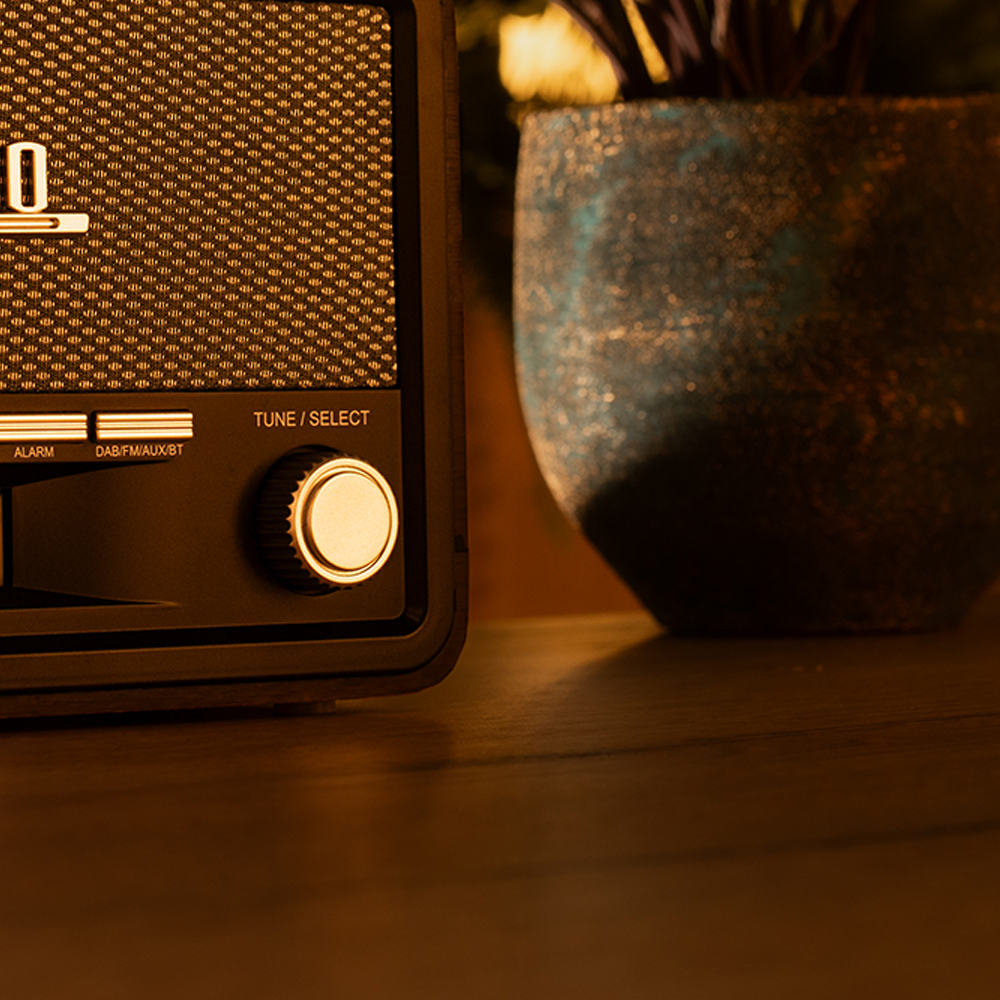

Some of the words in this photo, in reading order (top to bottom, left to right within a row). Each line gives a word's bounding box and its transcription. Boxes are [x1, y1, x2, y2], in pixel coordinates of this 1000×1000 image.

[253, 410, 297, 428] TUNE
[309, 409, 370, 427] SELECT
[13, 446, 54, 459] ALARM
[95, 443, 184, 458] DAB/FM/AUX/BT
